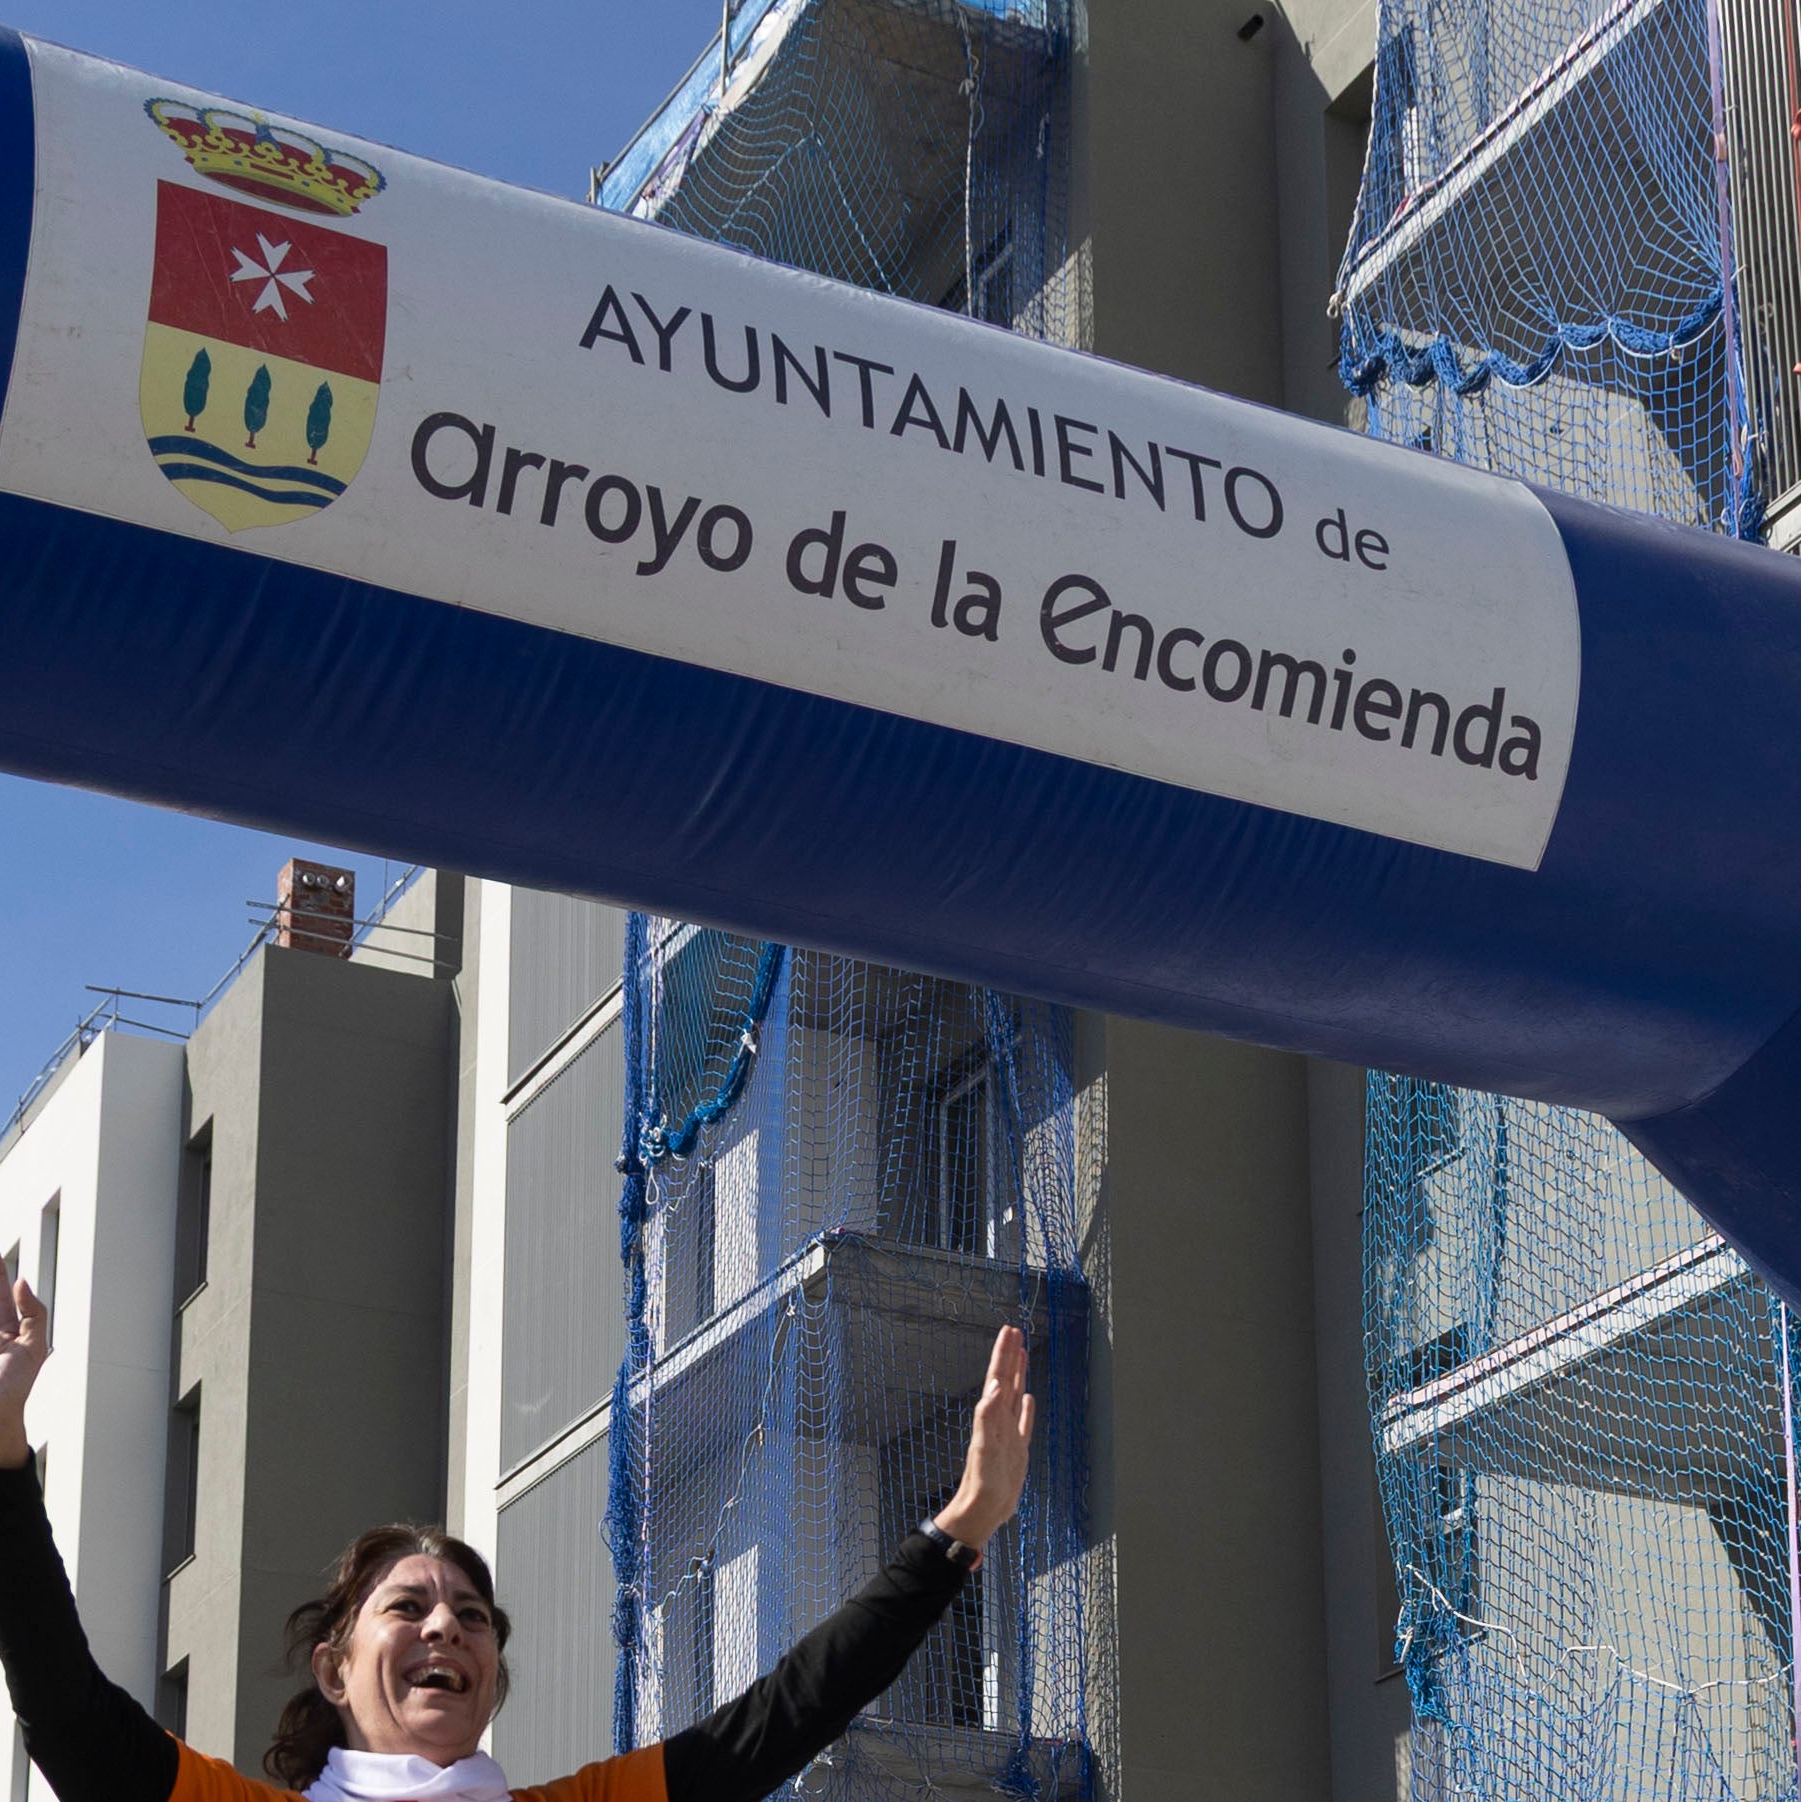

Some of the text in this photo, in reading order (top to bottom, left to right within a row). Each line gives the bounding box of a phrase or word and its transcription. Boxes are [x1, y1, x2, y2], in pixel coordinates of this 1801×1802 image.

[578, 282, 1390, 570] AYUNTAMIENTO de
[785, 508, 898, 611] de
[929, 538, 1001, 642] la
